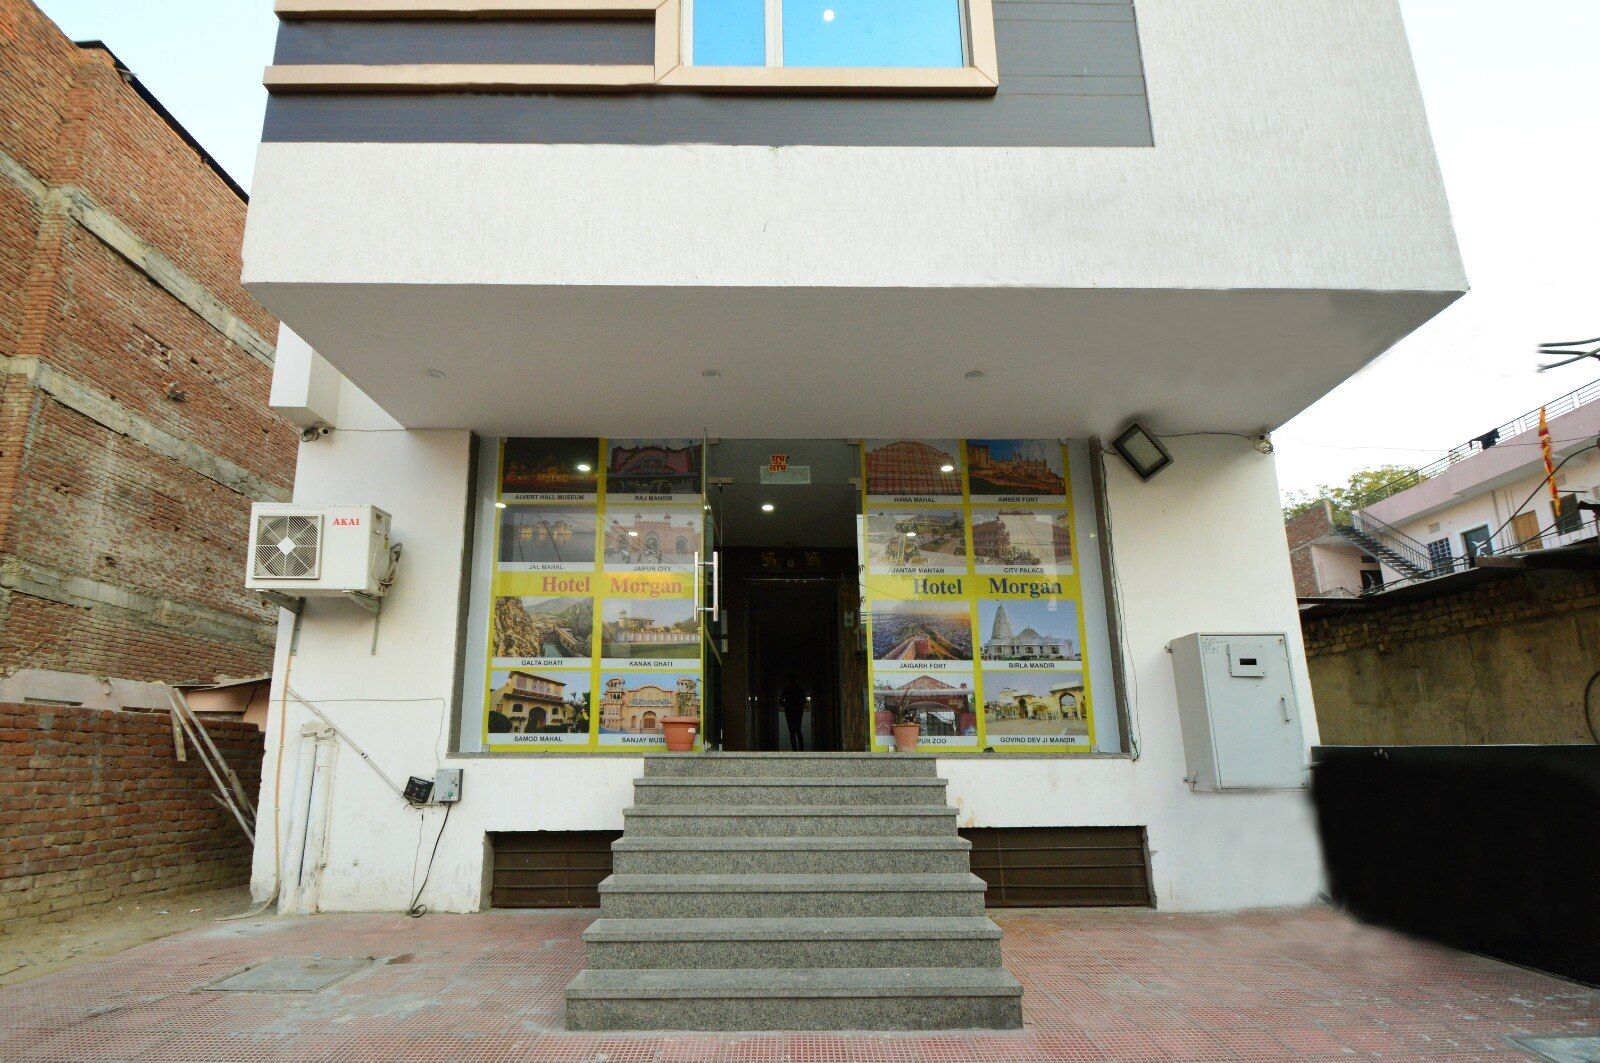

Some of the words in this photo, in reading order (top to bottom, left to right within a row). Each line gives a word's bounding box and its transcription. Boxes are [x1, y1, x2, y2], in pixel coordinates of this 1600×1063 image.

[333, 518, 360, 526] AKAI
[541, 576, 591, 593] Hotel
[610, 577, 683, 598] Morgan
[914, 578, 964, 595] Hotel
[988, 577, 1063, 598] Morgan
